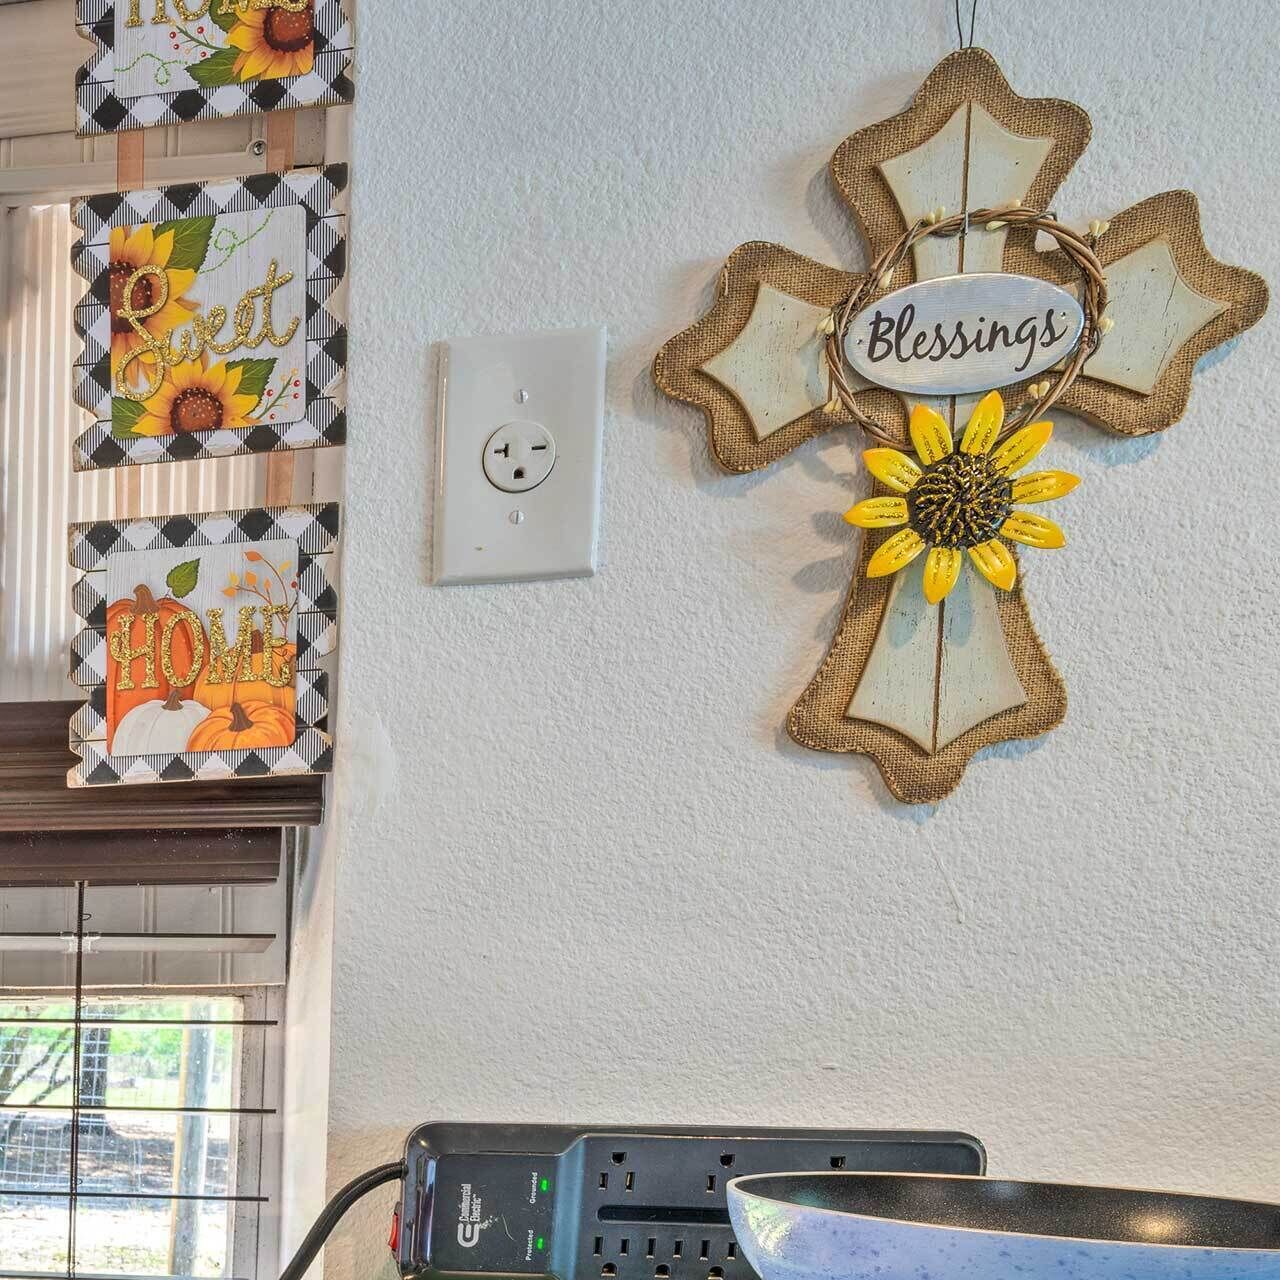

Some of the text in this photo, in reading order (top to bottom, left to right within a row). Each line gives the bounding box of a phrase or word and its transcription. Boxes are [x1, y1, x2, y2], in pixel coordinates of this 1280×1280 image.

[116, 258, 301, 400] Sweet
[867, 302, 1069, 372] Blessings
[109, 603, 295, 691] HOME
[459, 1183, 472, 1222] Commercial
[529, 1172, 538, 1204] Grounded
[525, 1229, 534, 1261] Protected
